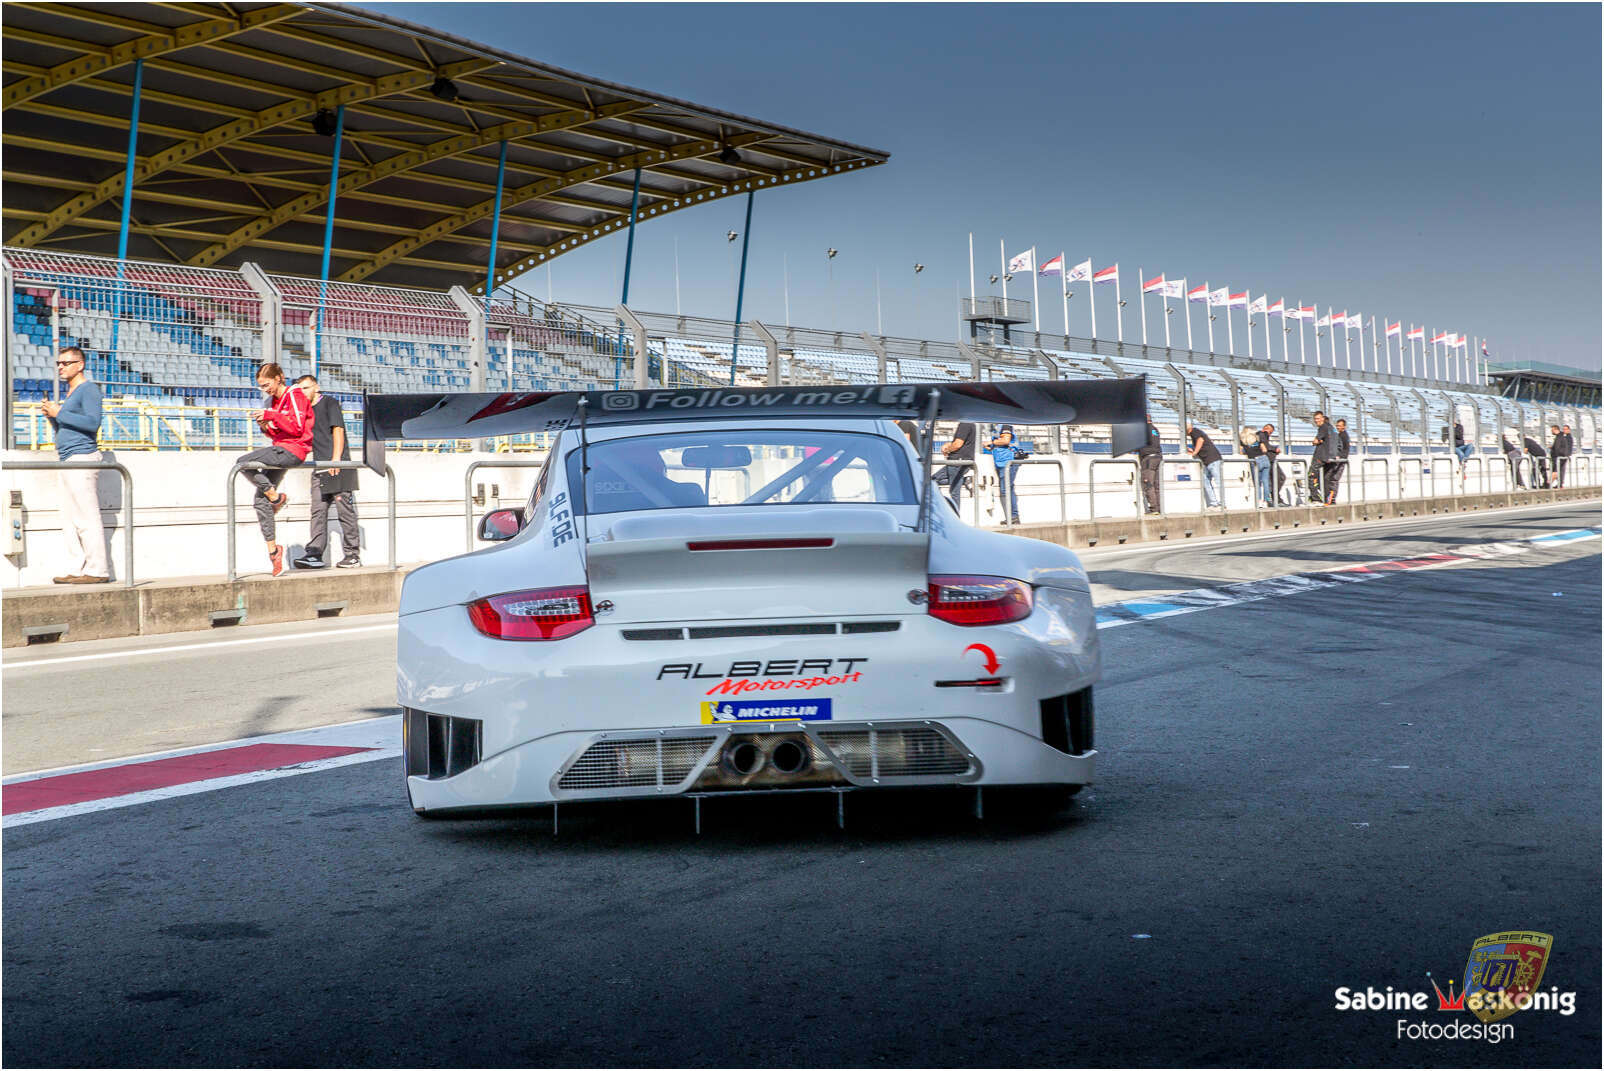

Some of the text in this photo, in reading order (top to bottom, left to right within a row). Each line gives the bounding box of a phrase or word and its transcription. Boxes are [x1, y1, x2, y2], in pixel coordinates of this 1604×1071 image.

[646, 387, 873, 409] Follow me!
[656, 658, 868, 680] ALBERT
[705, 671, 864, 696] Motorsport
[737, 705, 819, 718] MICHELIN
